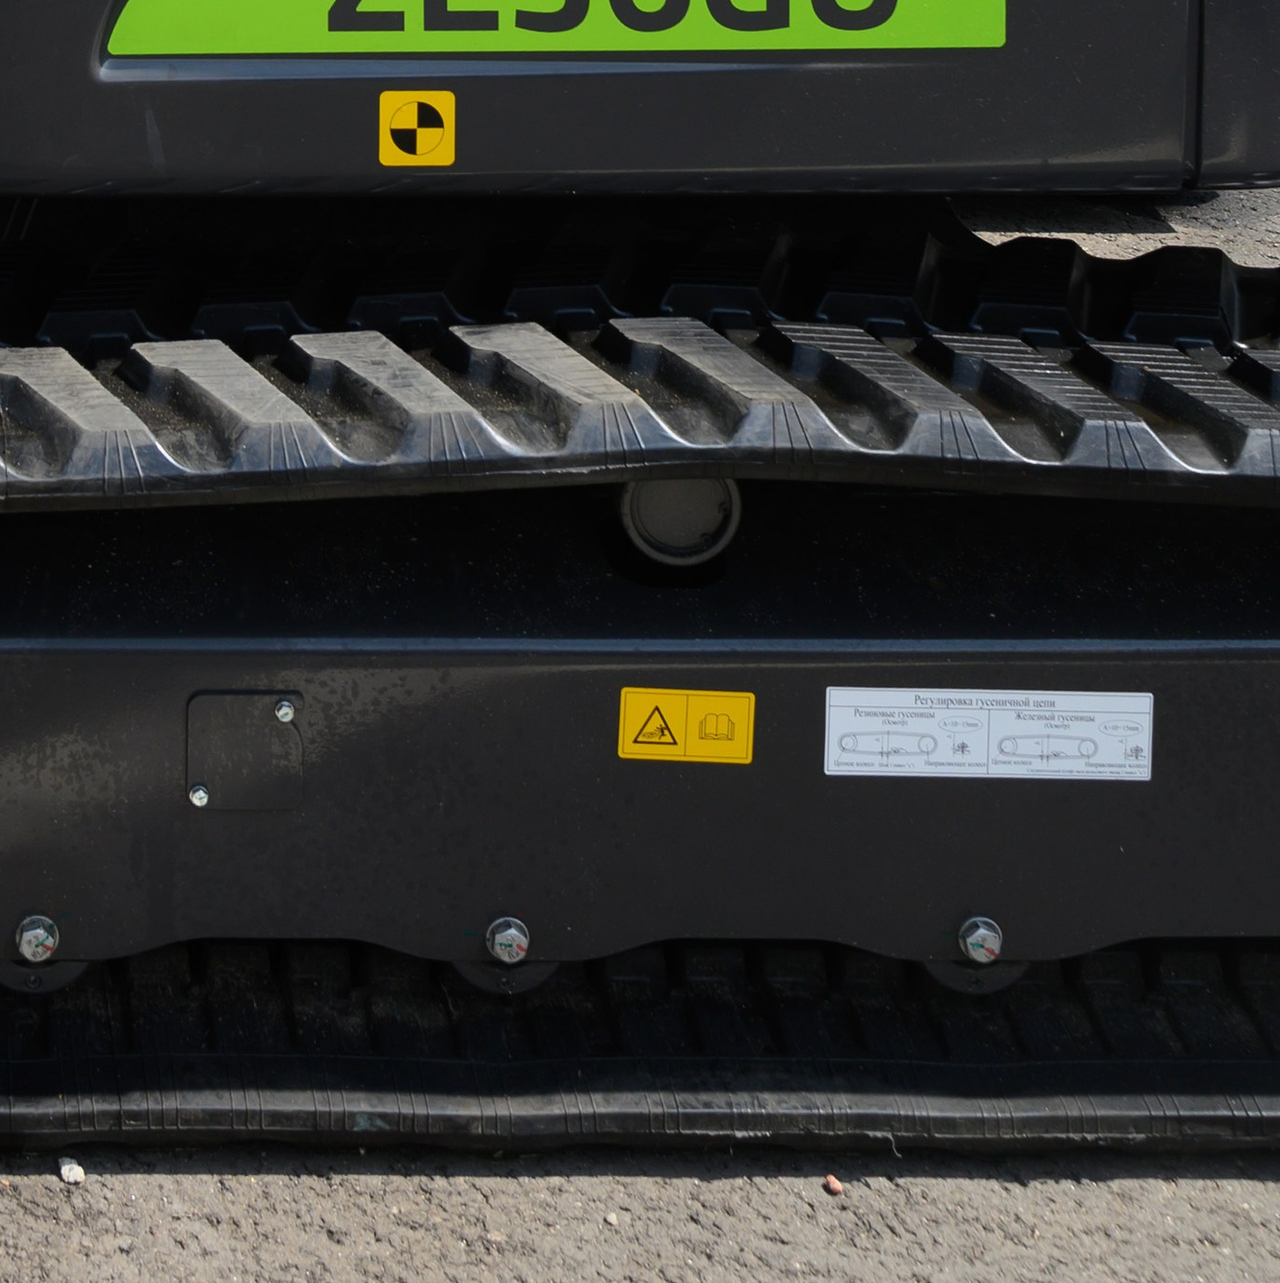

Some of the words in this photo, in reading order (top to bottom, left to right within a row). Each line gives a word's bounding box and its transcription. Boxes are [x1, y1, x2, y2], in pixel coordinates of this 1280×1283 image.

[914, 694, 973, 709] Регулировка
[975, 697, 1030, 710] гусеничной
[1032, 699, 1056, 709] цепи
[853, 708, 896, 718] Резиновые
[897, 710, 935, 719] гусеницы
[1014, 711, 1055, 721] Железный
[1056, 714, 1096, 723] гусеницы
